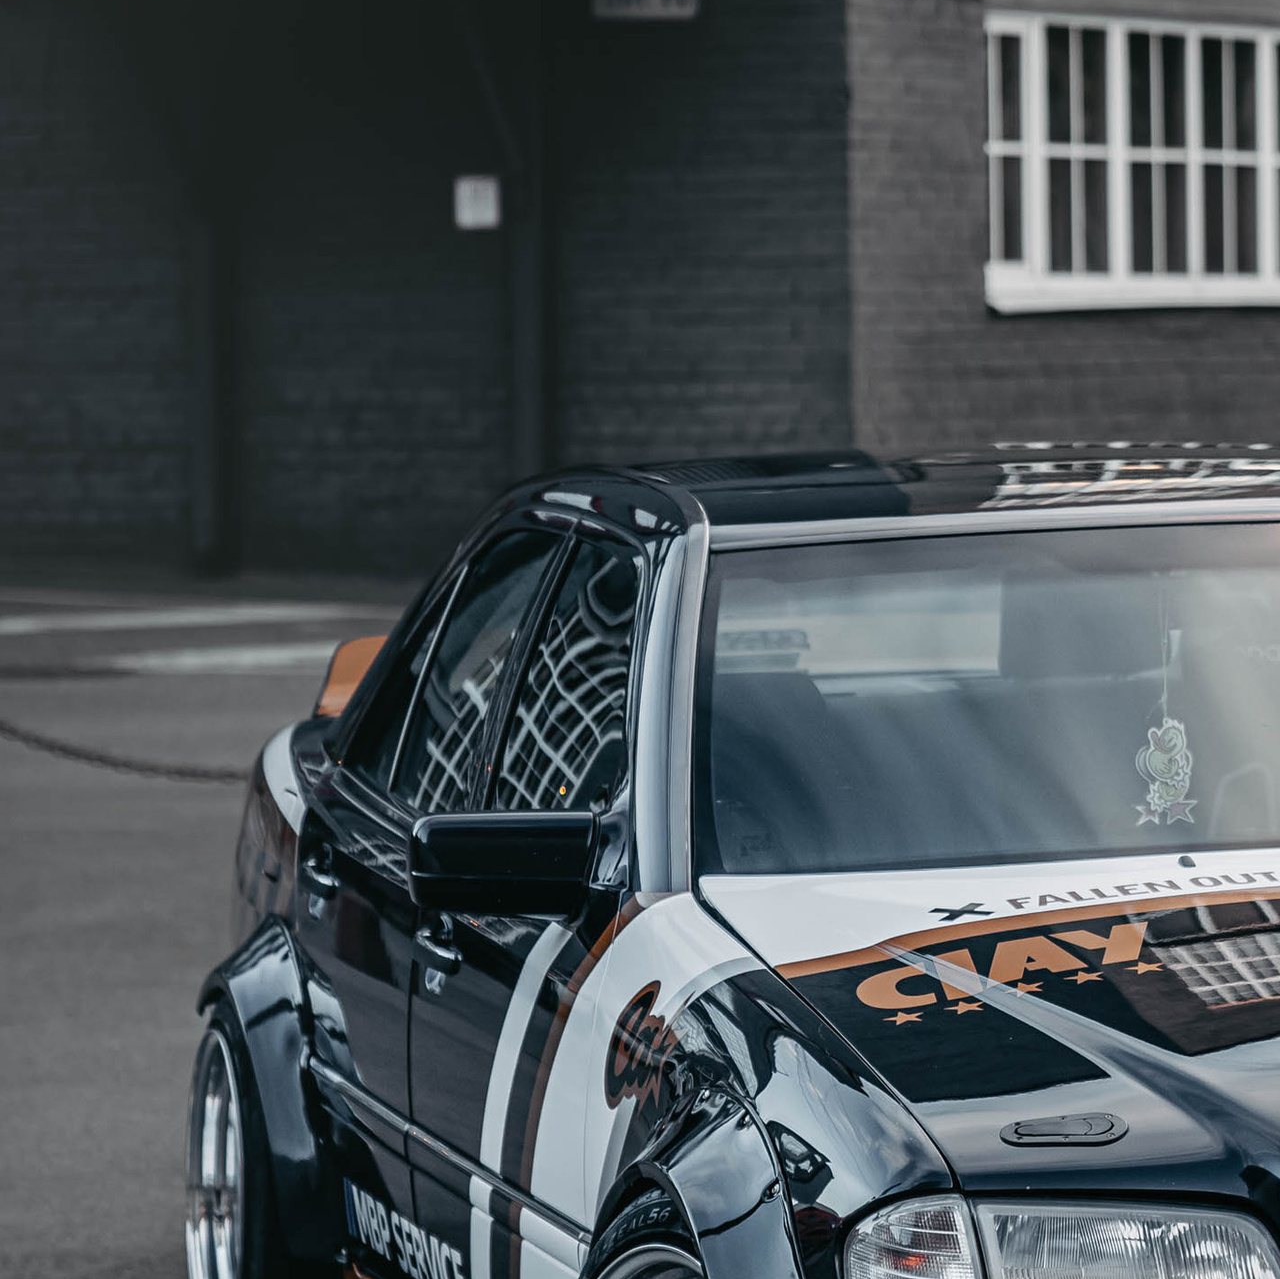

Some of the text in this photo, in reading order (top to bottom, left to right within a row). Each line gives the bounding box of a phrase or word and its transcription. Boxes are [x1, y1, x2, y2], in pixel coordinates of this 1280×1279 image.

[1005, 878, 1182, 910] FALLEN
[1188, 870, 1280, 889] OUT
[350, 1183, 393, 1262] MBP
